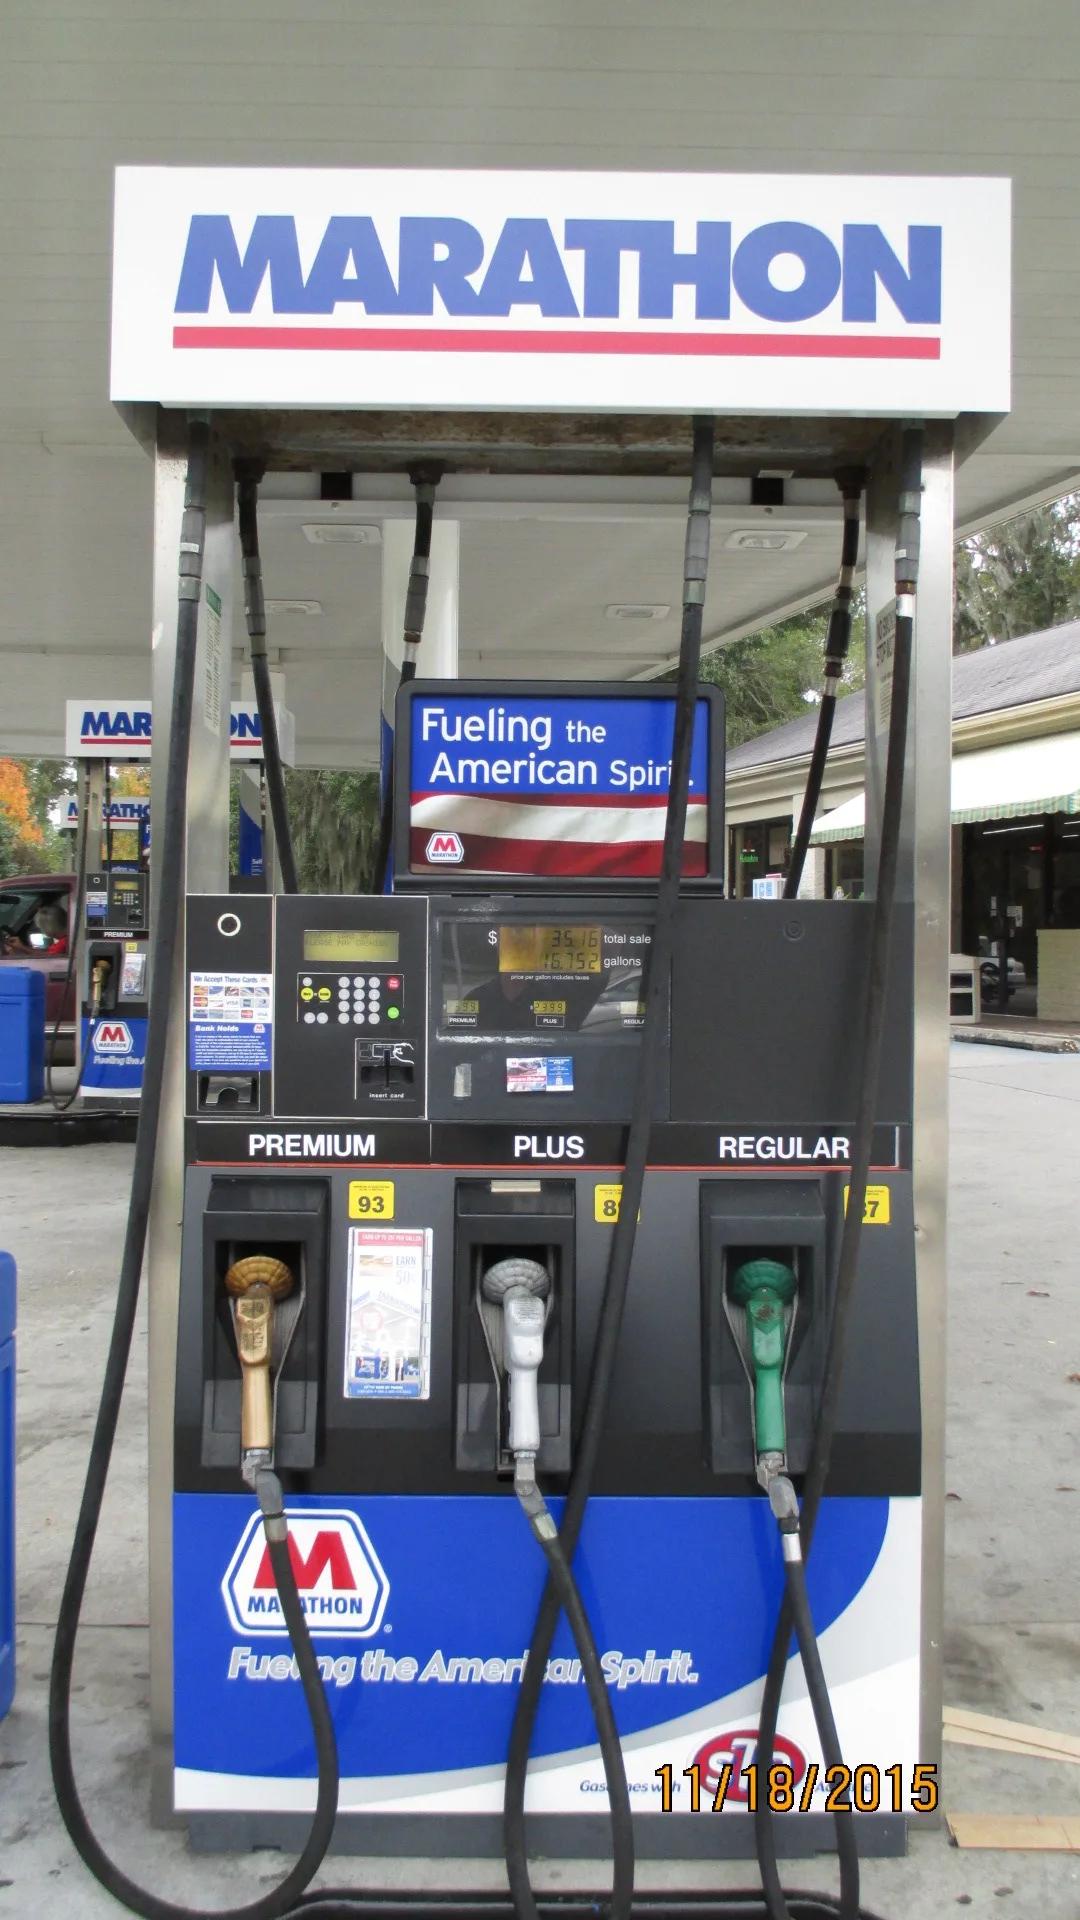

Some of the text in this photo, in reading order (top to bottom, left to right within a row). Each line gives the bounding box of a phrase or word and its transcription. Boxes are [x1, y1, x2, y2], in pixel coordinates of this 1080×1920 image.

[174, 214, 941, 324] MARATHON
[422, 708, 606, 750] Fueling the
[429, 752, 694, 791] American Spiri.
[433, 838, 456, 851] M
[604, 934, 651, 944] total sale
[603, 956, 642, 968] gallons
[204, 976, 223, 984] Accept
[249, 1134, 376, 1157] PREMIUM
[514, 1135, 584, 1158] PLUS
[719, 1136, 850, 1159] REGULAR
[358, 1196, 385, 1213] 93
[603, 1200, 620, 1217] 8
[864, 1201, 879, 1217] 7
[396, 1256, 416, 1265] EARN
[253, 1530, 358, 1591] M
[247, 1596, 363, 1614] MAATHON
[227, 1646, 699, 1689] Fuelng the Amerian Spirit.
[579, 1779, 648, 1793] Gasnes
